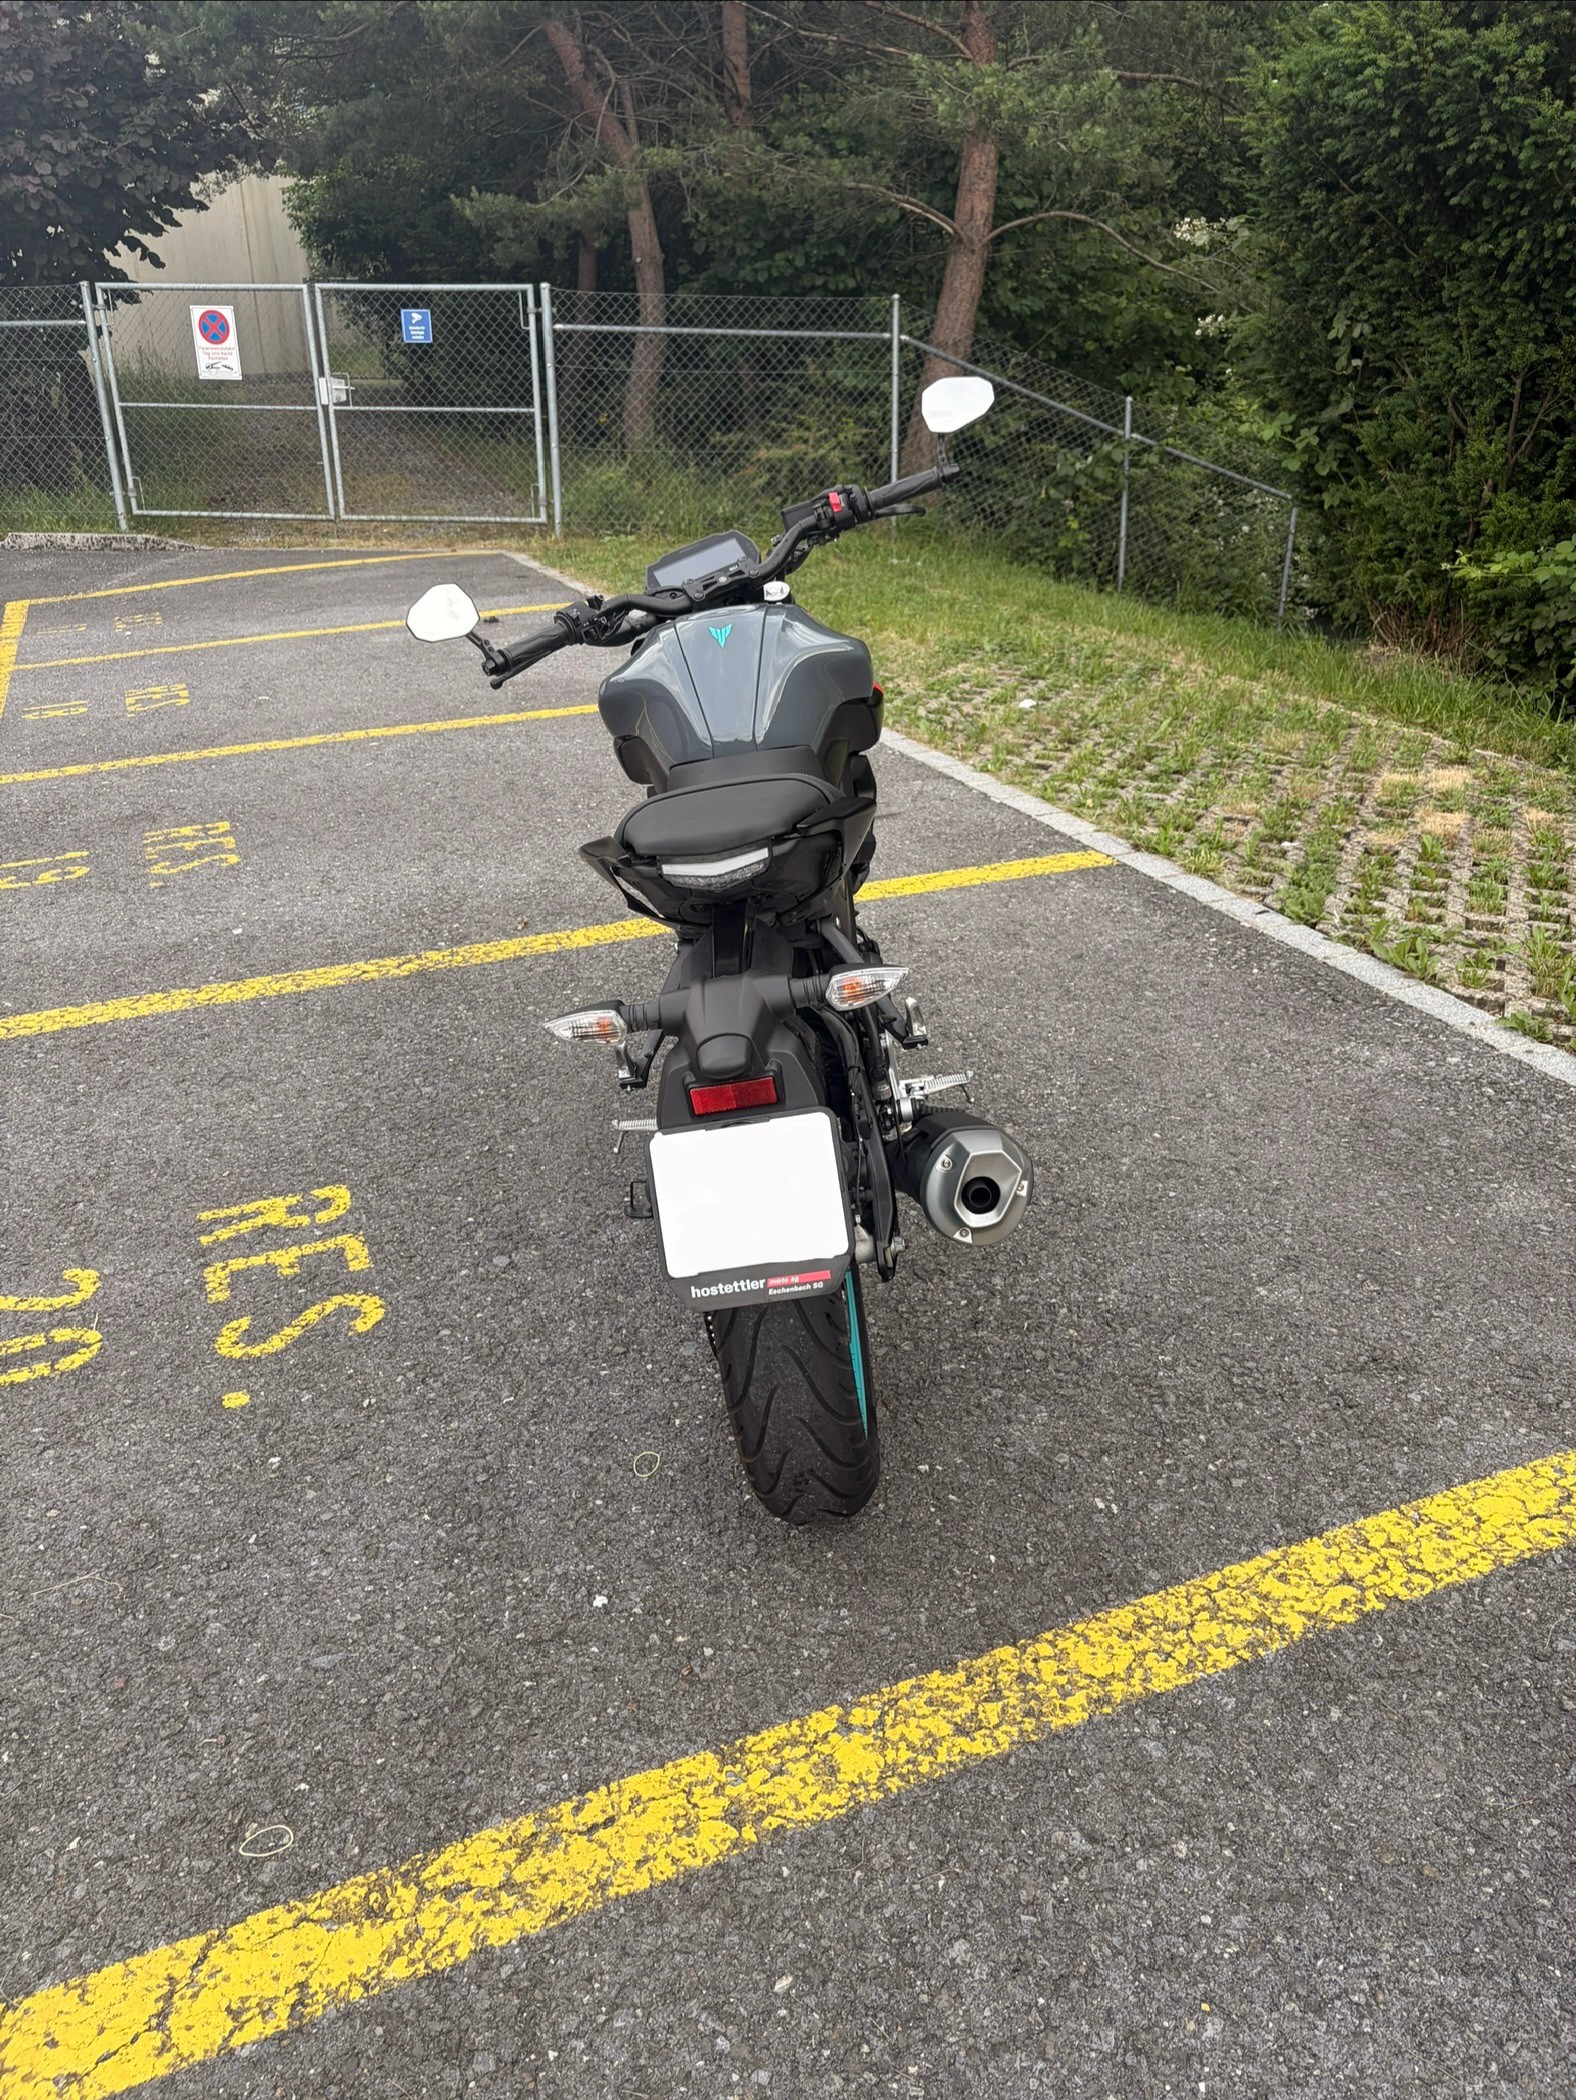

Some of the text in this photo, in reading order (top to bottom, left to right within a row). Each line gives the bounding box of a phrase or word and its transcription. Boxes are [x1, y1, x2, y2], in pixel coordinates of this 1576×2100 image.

[125, 683, 190, 718] RES.
[143, 820, 240, 888] RES.
[690, 1278, 766, 1298] hostettler
[768, 1281, 824, 1295] Eschenbach SG
[790, 1276, 800, 1284] ag
[197, 1184, 386, 1409] RES.
